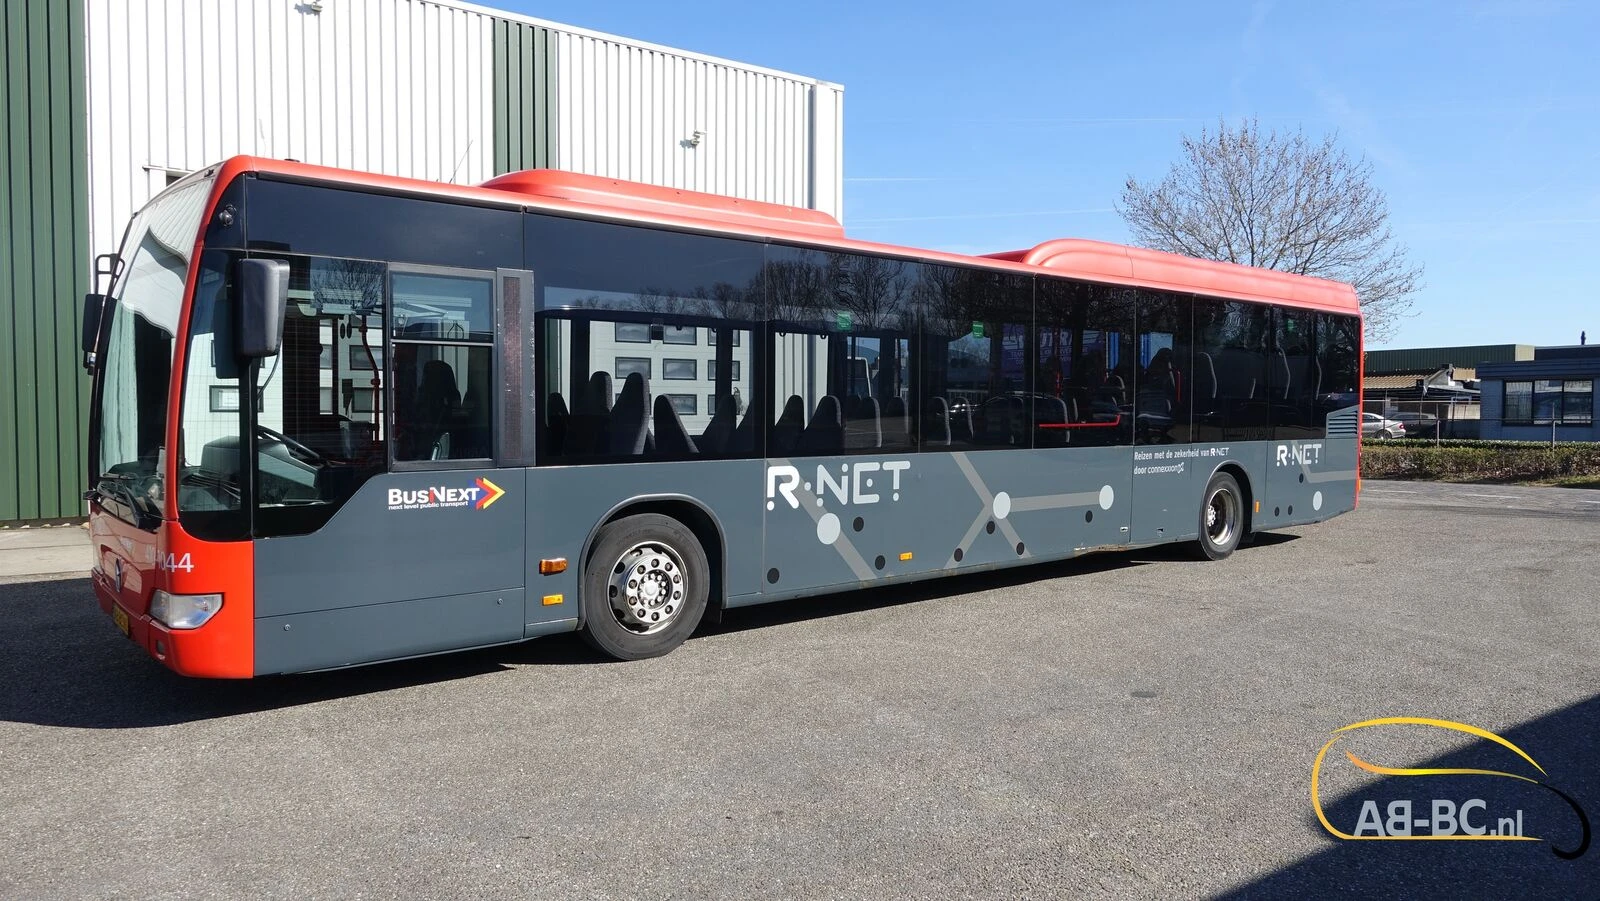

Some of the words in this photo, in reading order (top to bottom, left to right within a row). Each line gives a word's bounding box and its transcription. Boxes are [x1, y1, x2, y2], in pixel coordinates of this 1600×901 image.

[1134, 452, 1153, 461] Reizen
[1154, 451, 1165, 460] met
[1166, 450, 1173, 459] de
[1174, 448, 1199, 458] zekerheid
[1134, 466, 1147, 475] door
